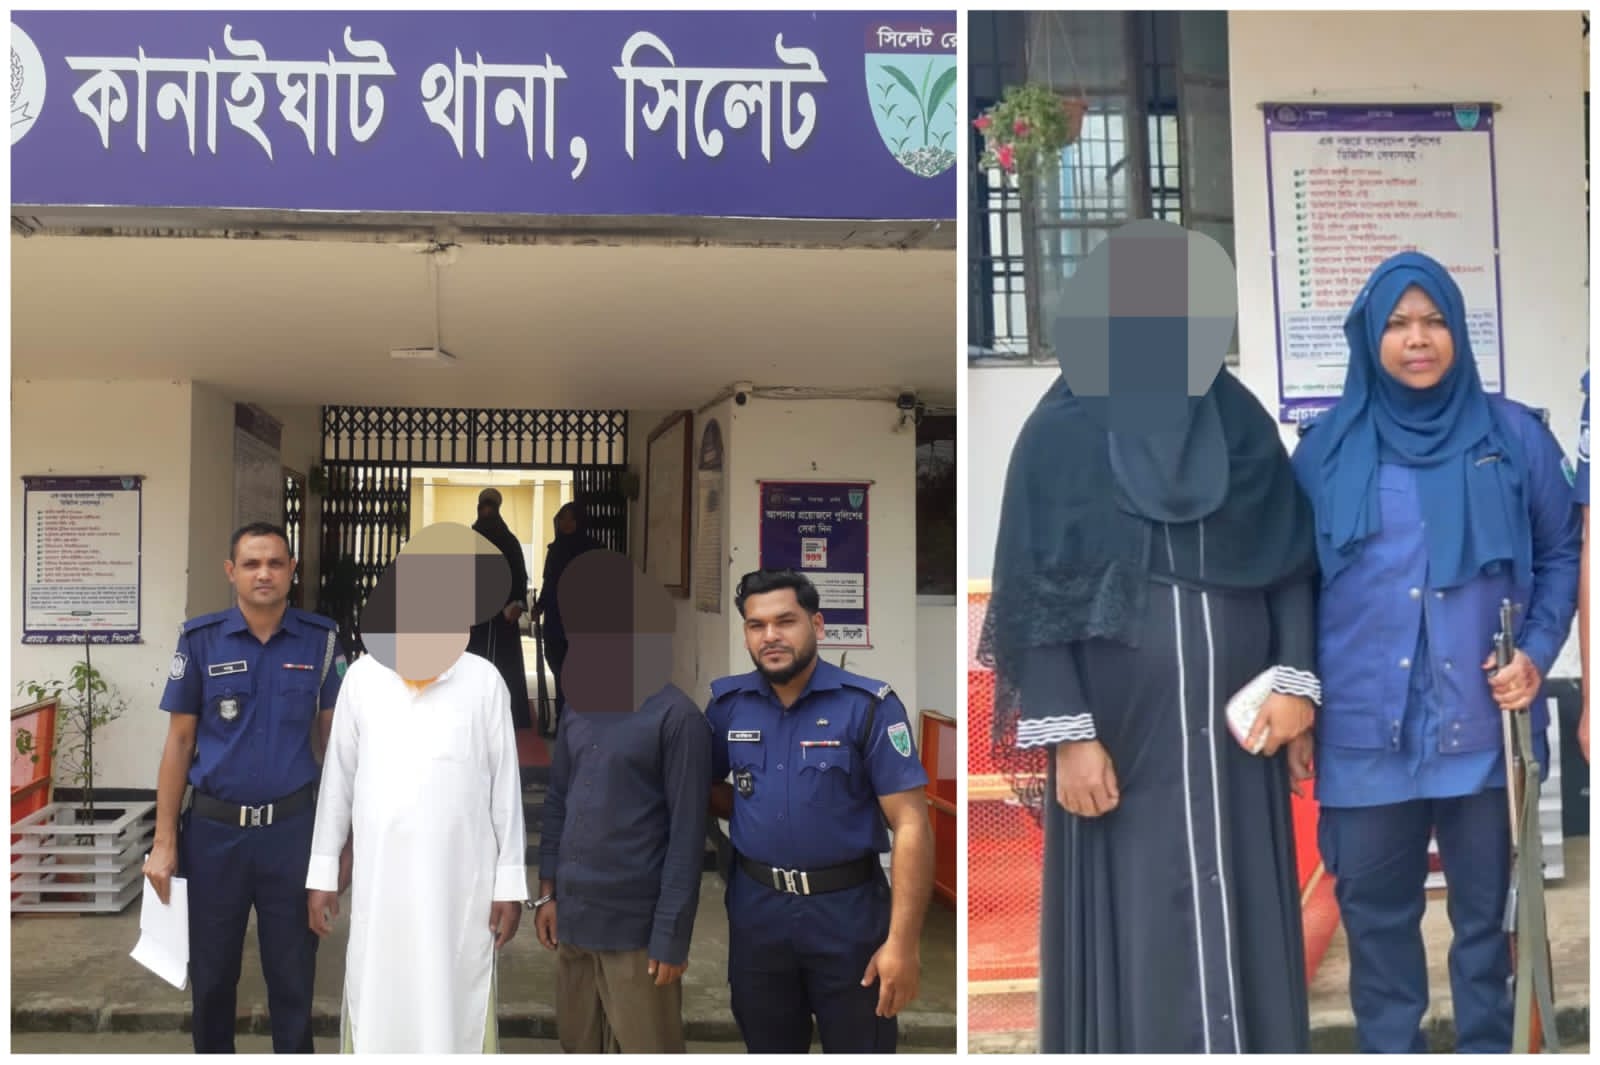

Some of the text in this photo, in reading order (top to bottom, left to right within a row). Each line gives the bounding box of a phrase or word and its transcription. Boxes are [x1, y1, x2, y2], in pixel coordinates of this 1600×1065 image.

[876, 26, 934, 48] সিলেট
[65, 24, 828, 180] কানাইঘাট থানা, সিলেট
